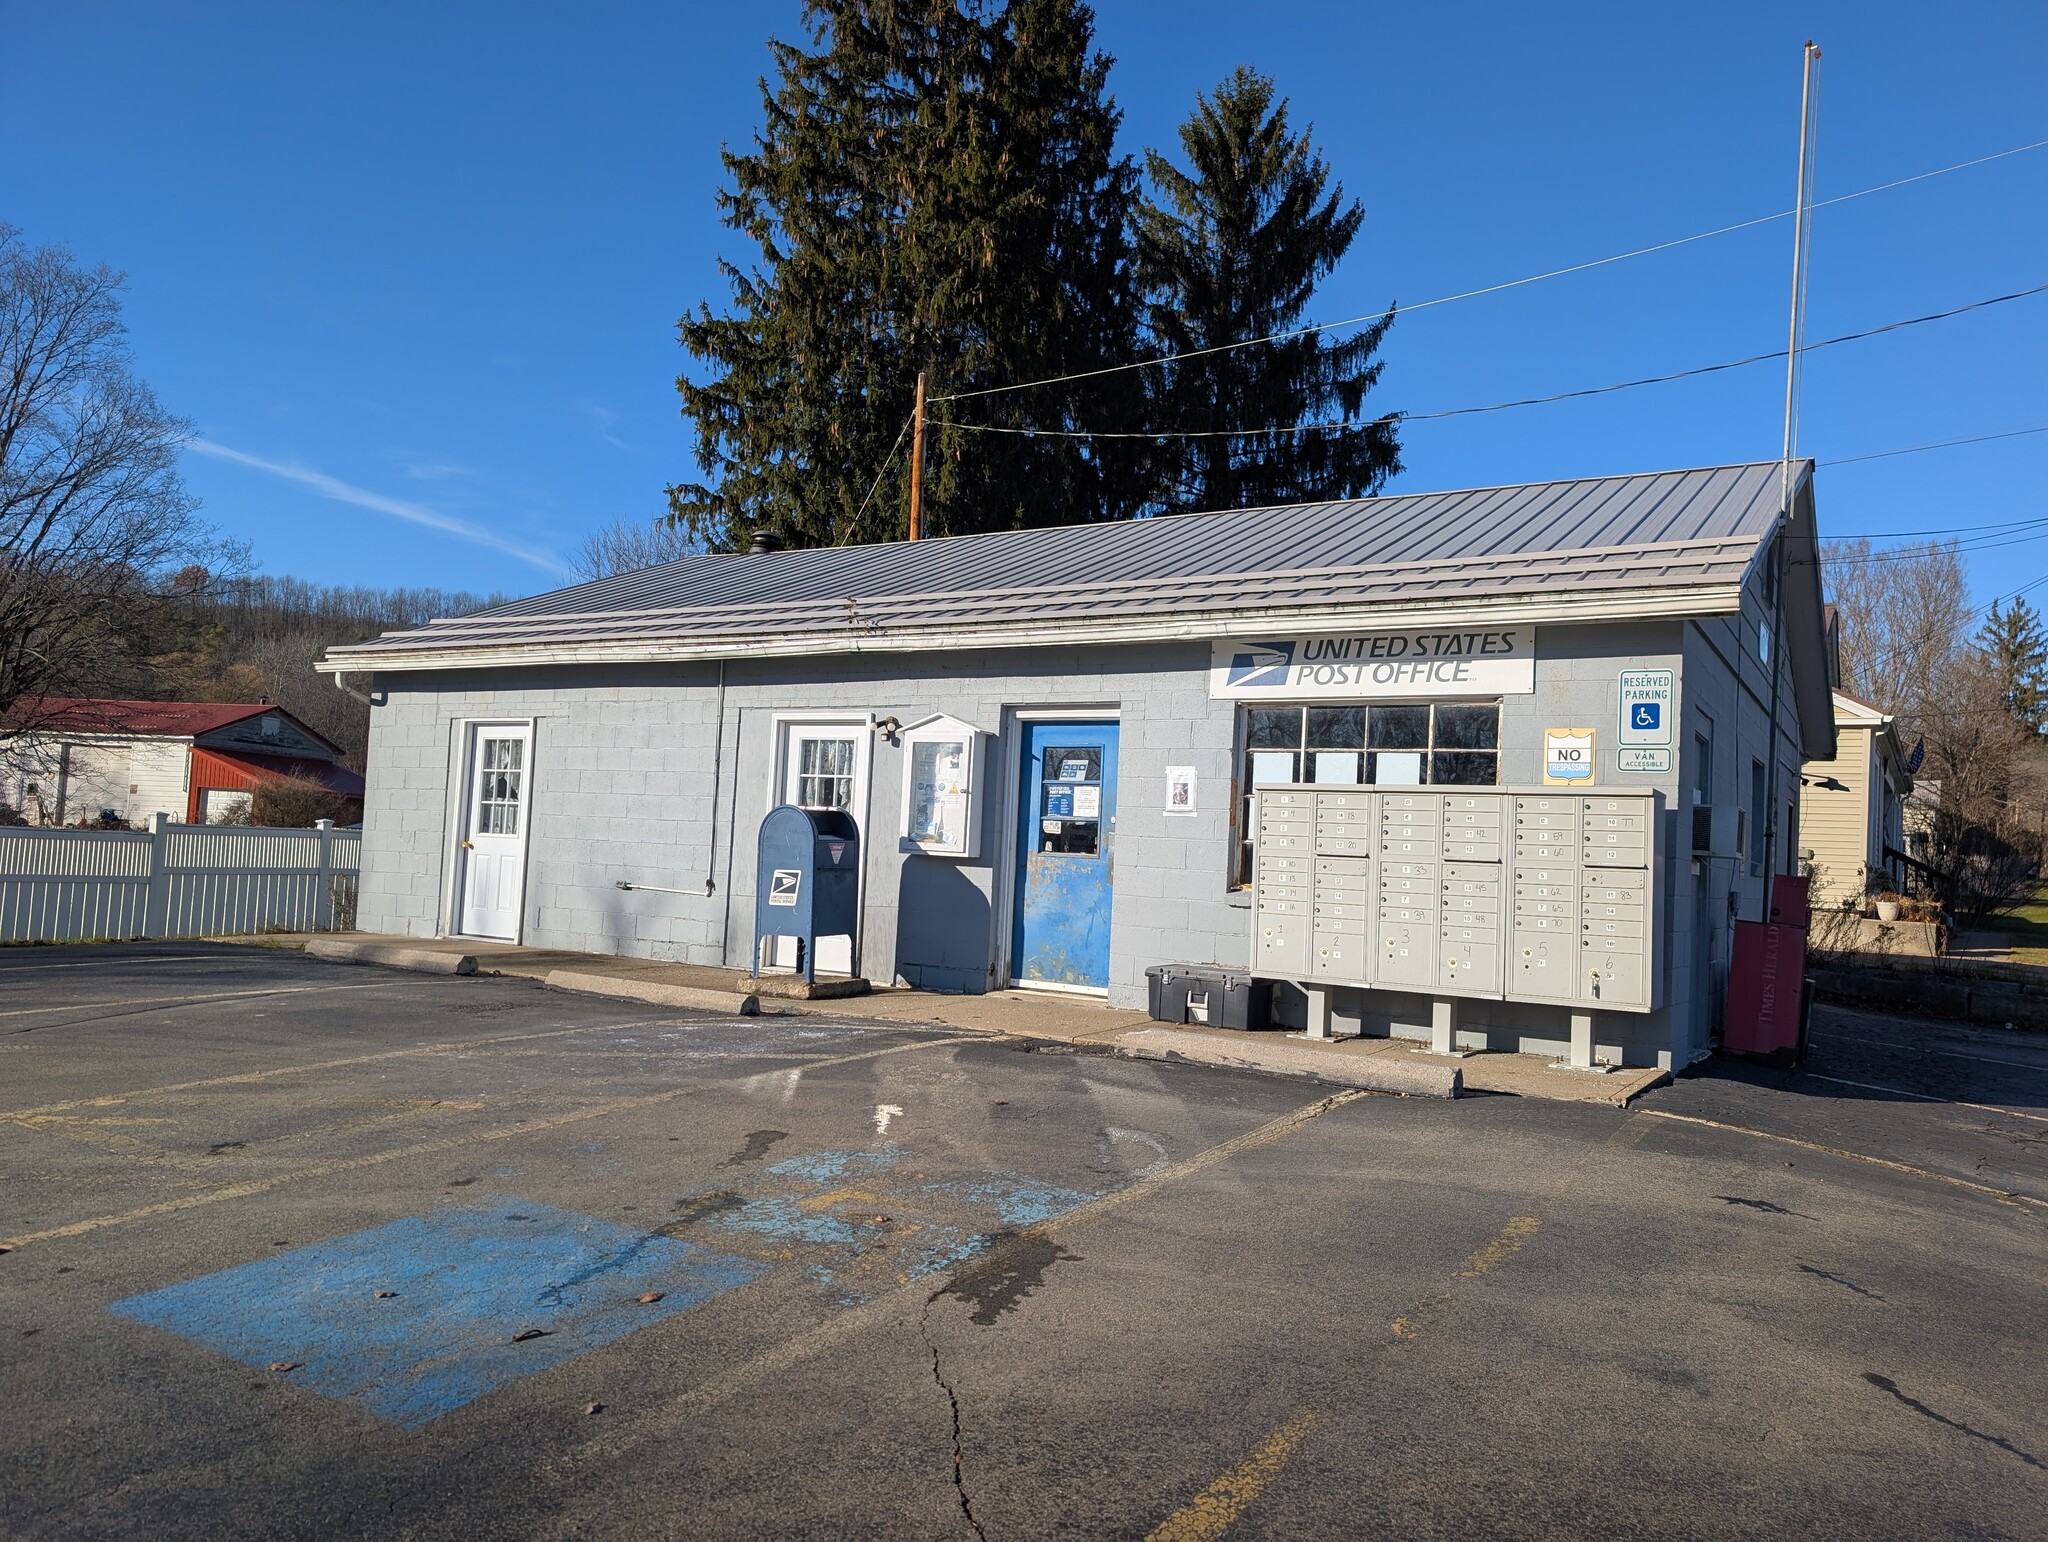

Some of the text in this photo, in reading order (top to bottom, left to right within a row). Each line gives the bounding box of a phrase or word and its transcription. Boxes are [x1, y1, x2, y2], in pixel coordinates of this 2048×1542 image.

[1303, 632, 1516, 660] UNITED STATES
[1296, 663, 1370, 686] POST
[1372, 660, 1472, 684] OFFICE
[1624, 677, 1670, 687] RESERVED
[1625, 690, 1668, 700] PARKING
[1558, 750, 1581, 761] NO
[1548, 763, 1590, 772] TRESPASSING
[1622, 818, 1634, 826] 77
[1553, 832, 1563, 840] 59
[1554, 848, 1564, 856] 60
[1414, 866, 1427, 875] 33
[1475, 884, 1487, 892] 45
[1620, 891, 1632, 900] 83
[1552, 904, 1564, 912] 65
[1414, 910, 1425, 920] 39
[1475, 915, 1485, 923] 48
[1552, 919, 1562, 927] 70
[1278, 925, 1283, 933] 1
[1334, 936, 1339, 946] 2
[1402, 929, 1410, 943] 3
[1464, 946, 1470, 957] 4
[1539, 942, 1548, 956] 5
[1606, 956, 1613, 969] 6
[1758, 926, 1780, 1025] TIMES HERALD
